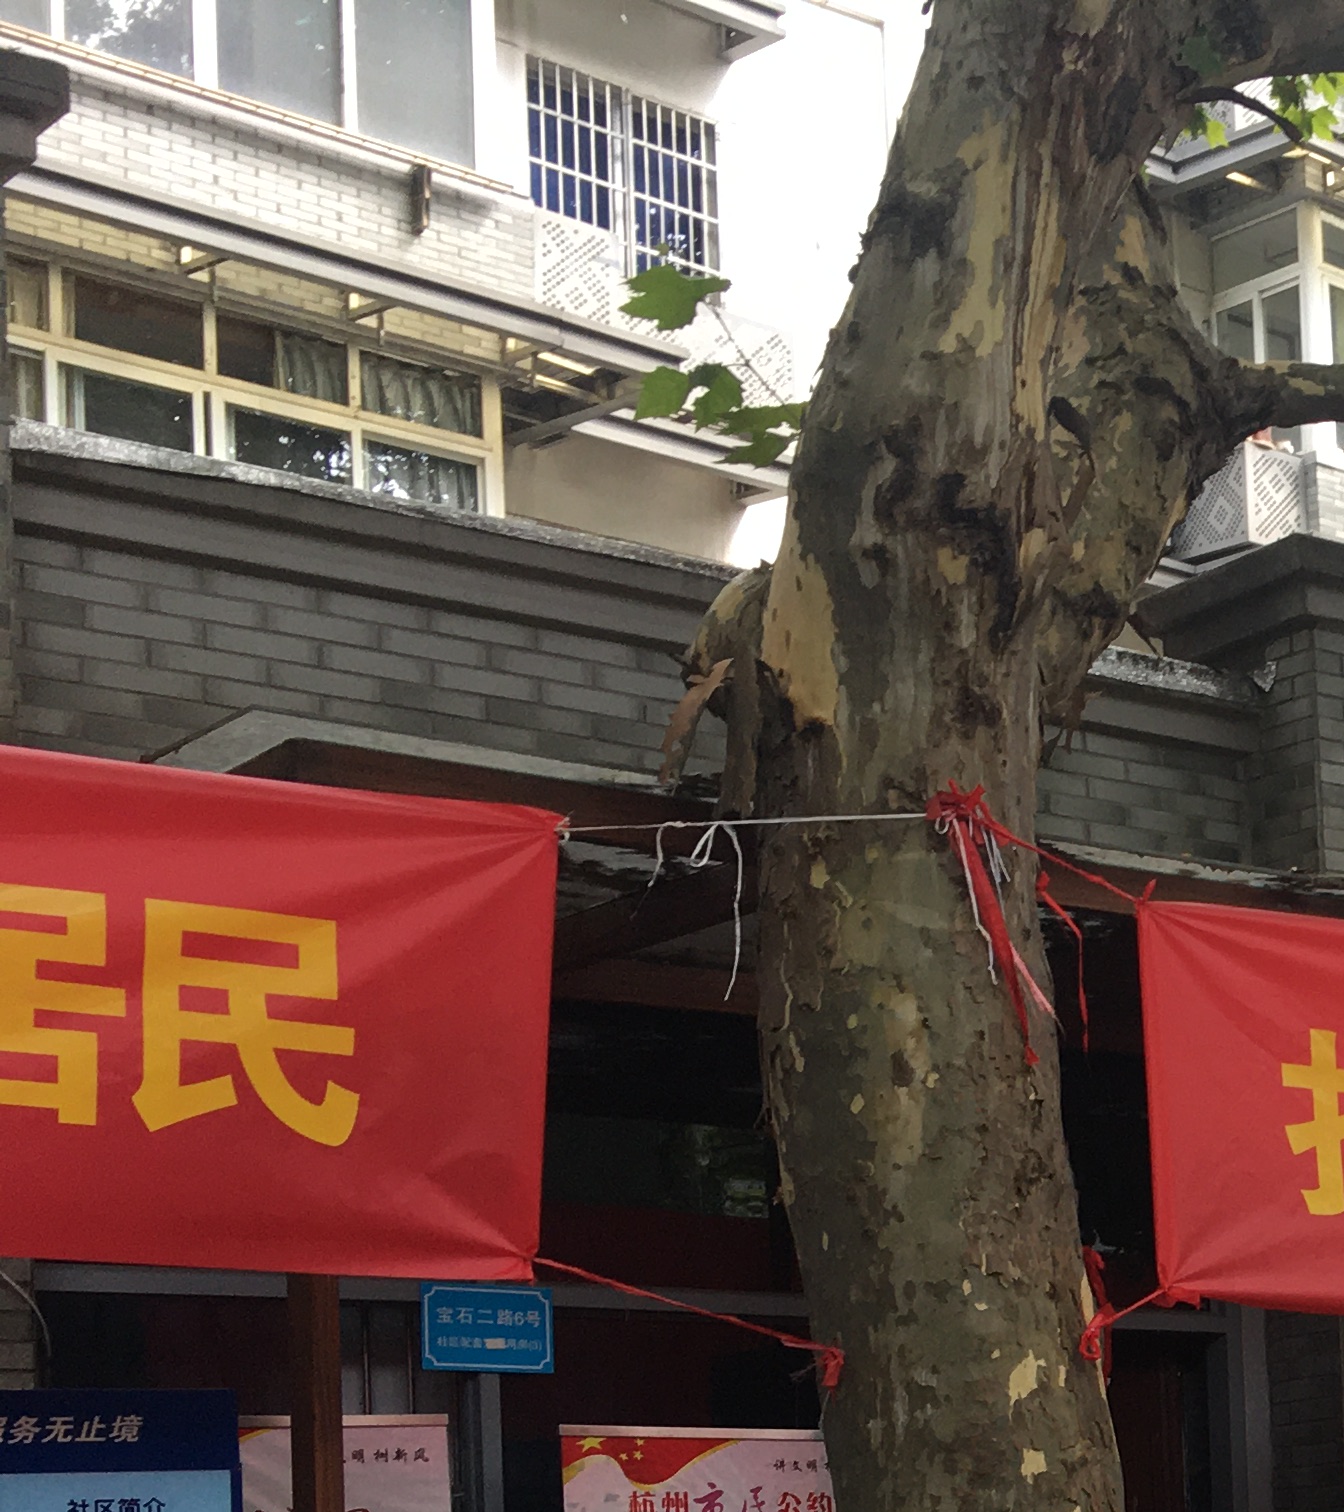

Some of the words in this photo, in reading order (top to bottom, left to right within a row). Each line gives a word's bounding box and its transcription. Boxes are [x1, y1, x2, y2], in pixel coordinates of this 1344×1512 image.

[436, 1307, 541, 1328] 宝石二路6号
